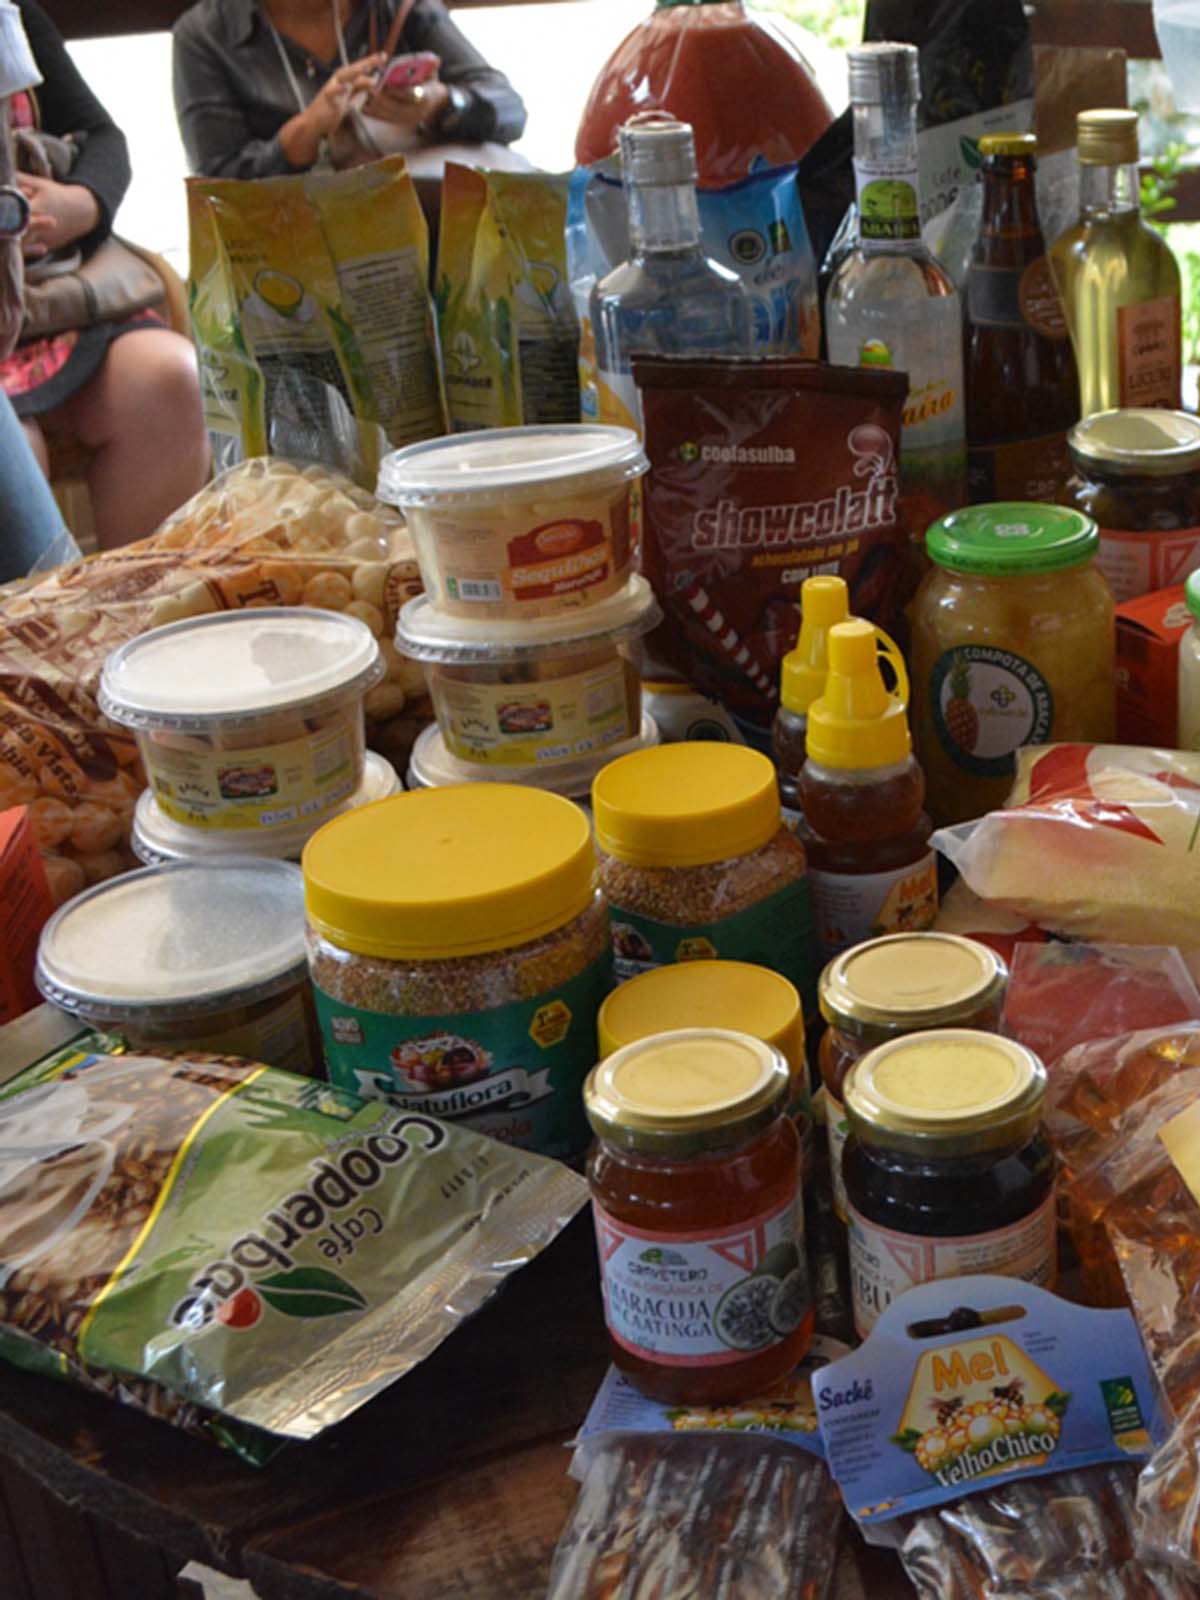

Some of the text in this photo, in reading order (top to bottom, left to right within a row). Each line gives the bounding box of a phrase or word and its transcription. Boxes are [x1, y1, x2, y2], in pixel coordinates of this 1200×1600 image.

[964, 647, 1029, 677] COMPOTA
[318, 1207, 385, 1266] Café
[931, 1341, 1010, 1393] Mel
